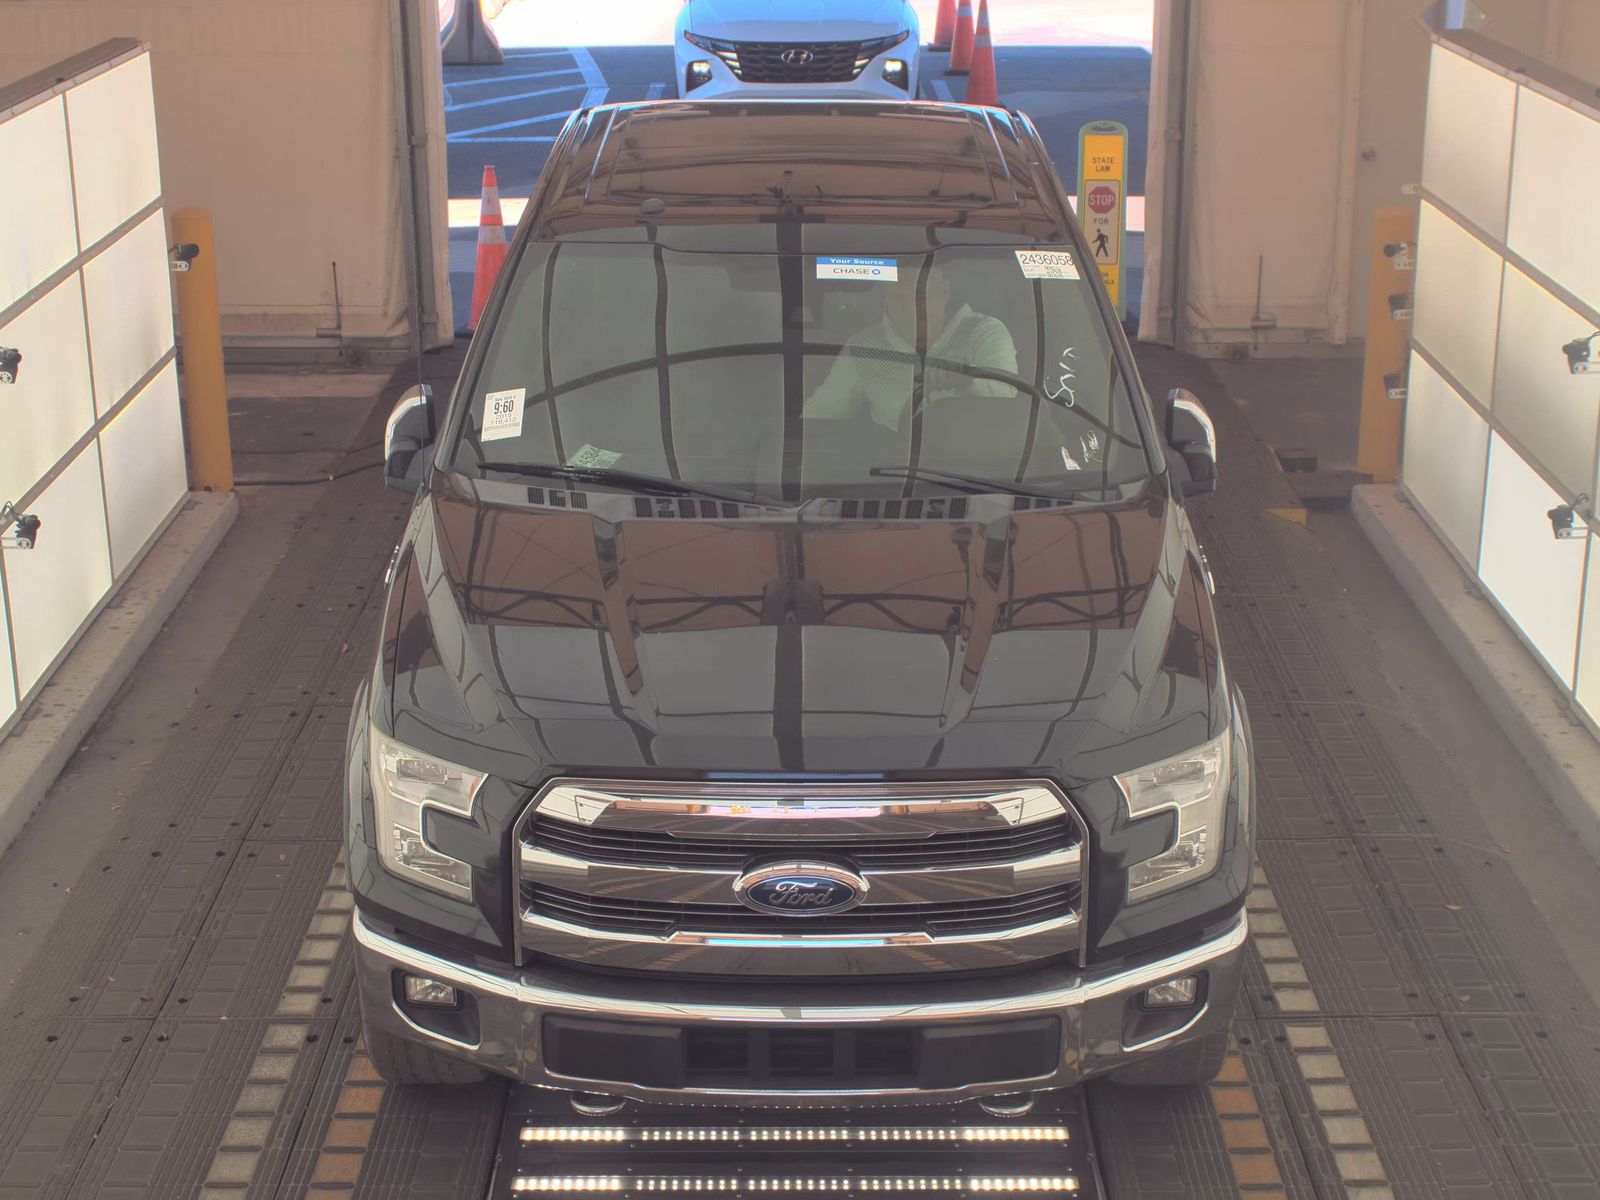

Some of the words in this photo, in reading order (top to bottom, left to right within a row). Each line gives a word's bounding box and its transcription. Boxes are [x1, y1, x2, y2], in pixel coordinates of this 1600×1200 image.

[1092, 156, 1115, 164] STATE
[1089, 194, 1115, 206] STOP
[1093, 217, 1109, 225] FOR
[1020, 253, 1075, 266] 2436058
[833, 267, 869, 275] CHASE
[494, 400, 514, 414] 9:60
[768, 881, 834, 905] Ford
